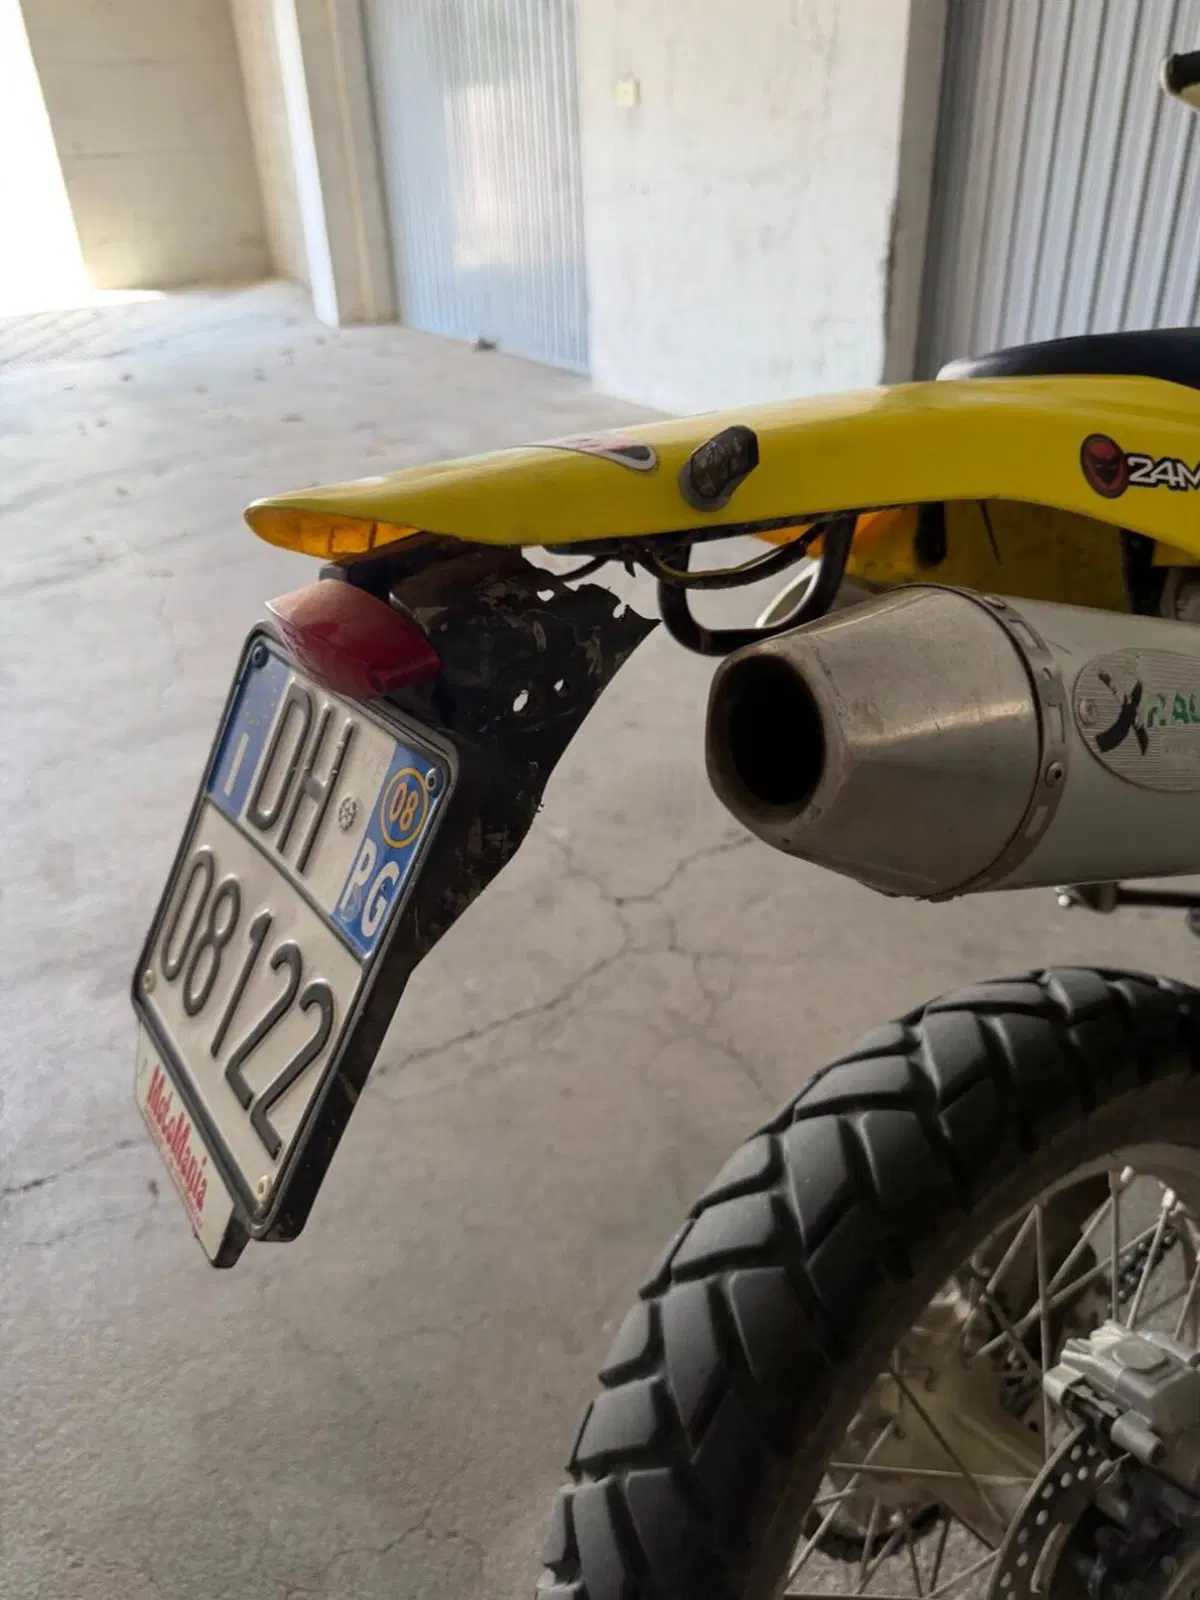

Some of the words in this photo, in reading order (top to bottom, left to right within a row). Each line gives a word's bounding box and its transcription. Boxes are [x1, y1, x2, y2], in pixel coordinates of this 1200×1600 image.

[245, 681, 355, 876] DH
[389, 781, 420, 832] 08
[339, 838, 400, 938] PG
[160, 846, 335, 1161] 08122
